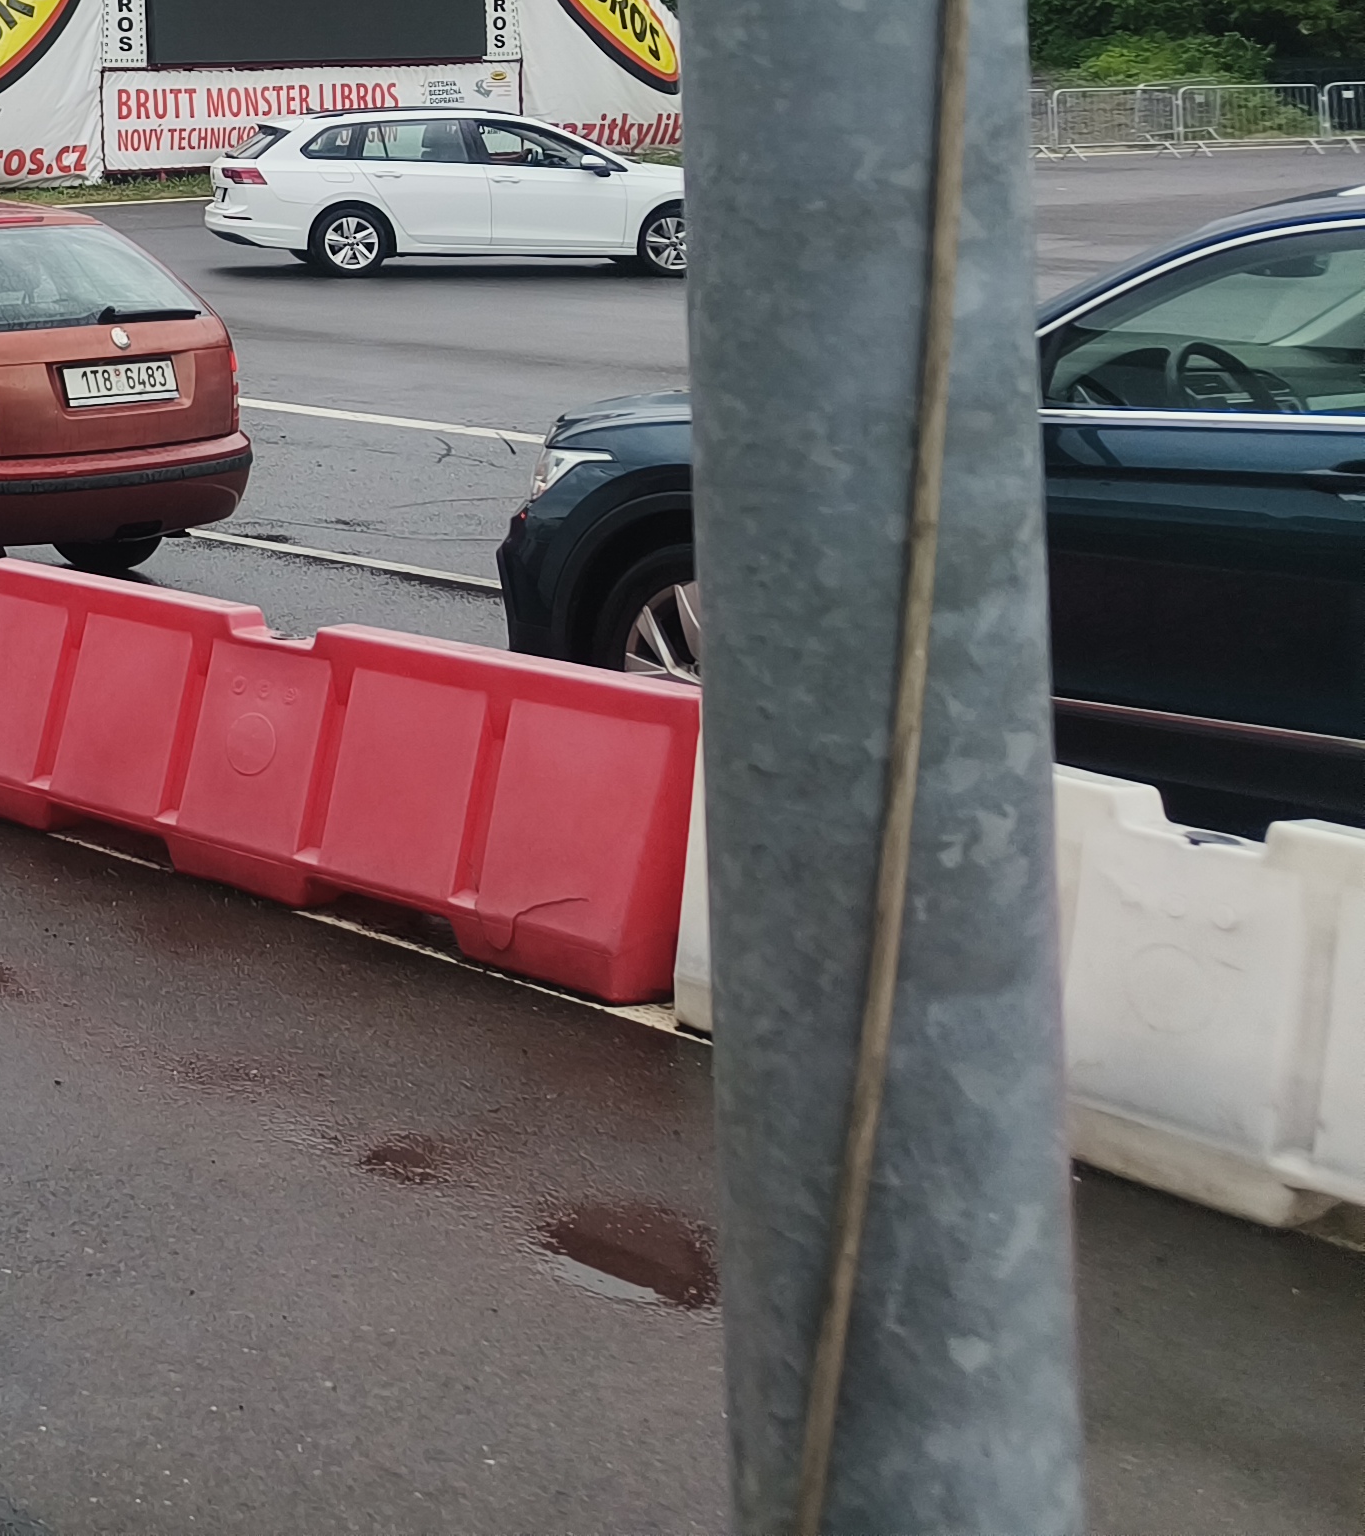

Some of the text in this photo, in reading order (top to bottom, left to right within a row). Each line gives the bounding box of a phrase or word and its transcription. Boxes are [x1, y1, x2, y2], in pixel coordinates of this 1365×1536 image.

[117, 82, 399, 120] BRUTT MONSTER LIBROS
[117, 123, 164, 152] NOVÝ
[81, 365, 167, 393] 1T8 6483
